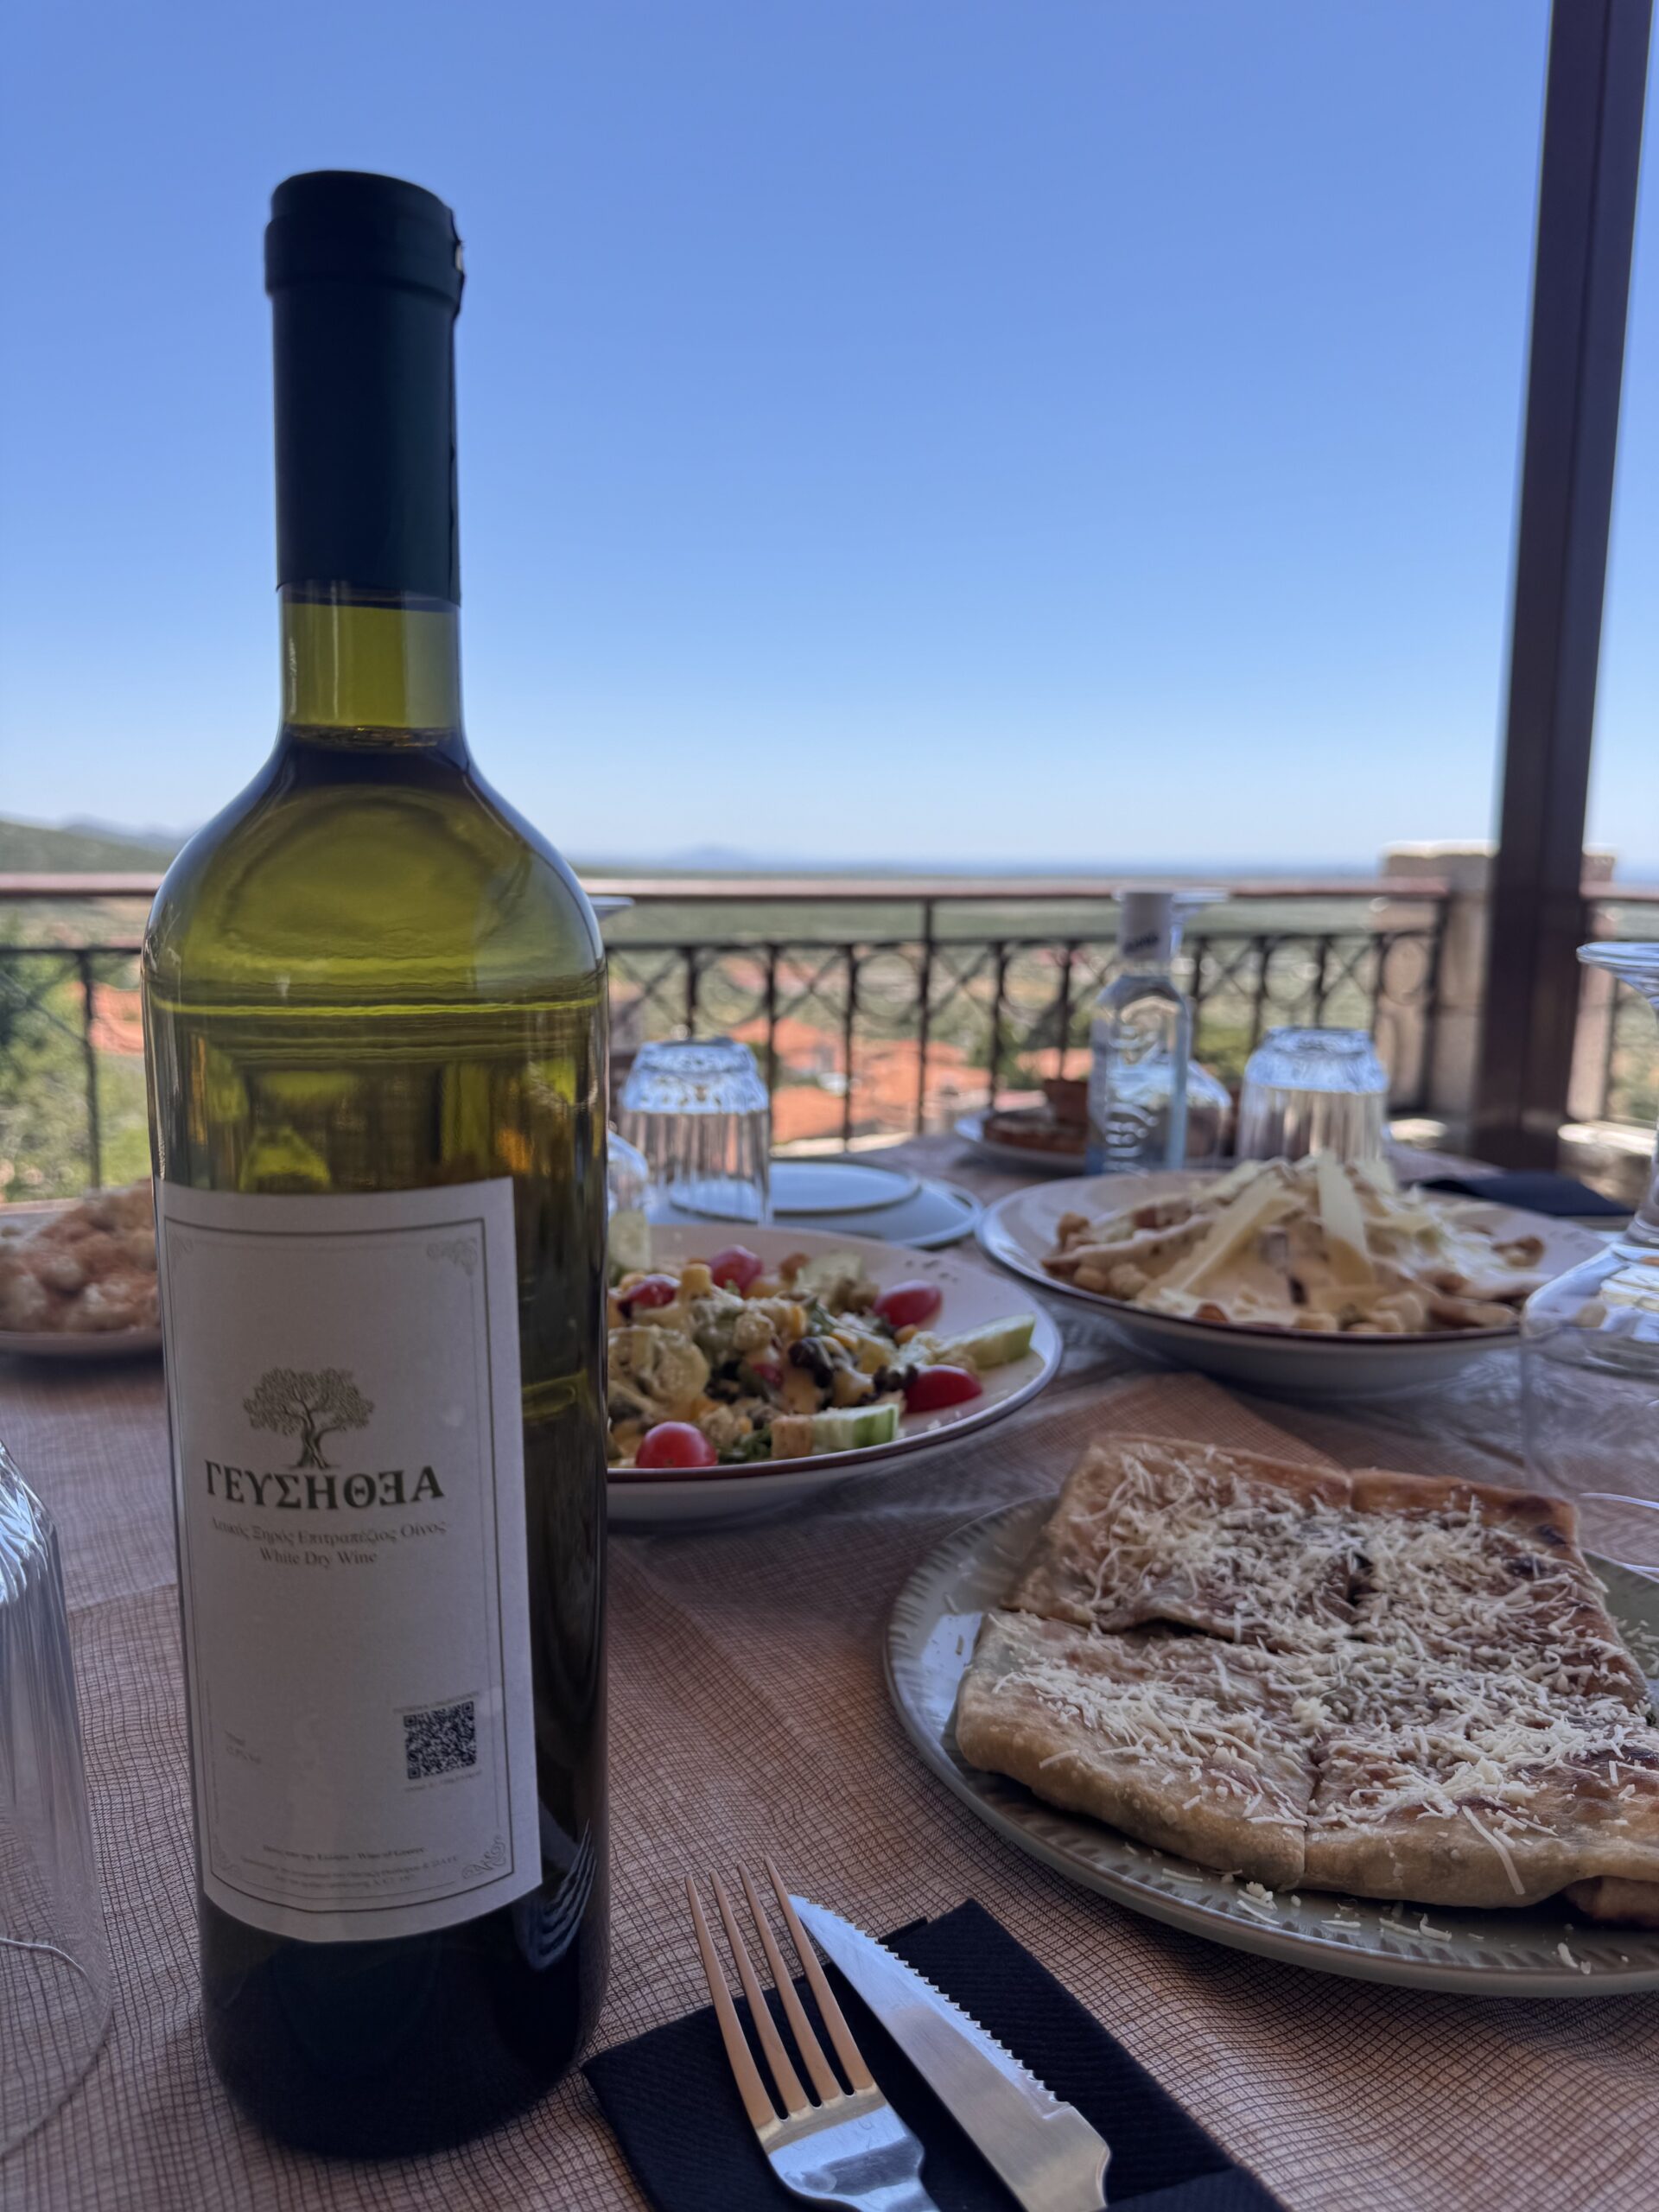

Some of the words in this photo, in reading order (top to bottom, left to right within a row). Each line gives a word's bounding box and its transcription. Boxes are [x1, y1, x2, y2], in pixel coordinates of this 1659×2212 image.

[400, 1521, 447, 1538] Οίνος
[260, 1547, 301, 1566] White
[304, 1550, 331, 1569] Dry
[337, 1550, 378, 1566] Wine
